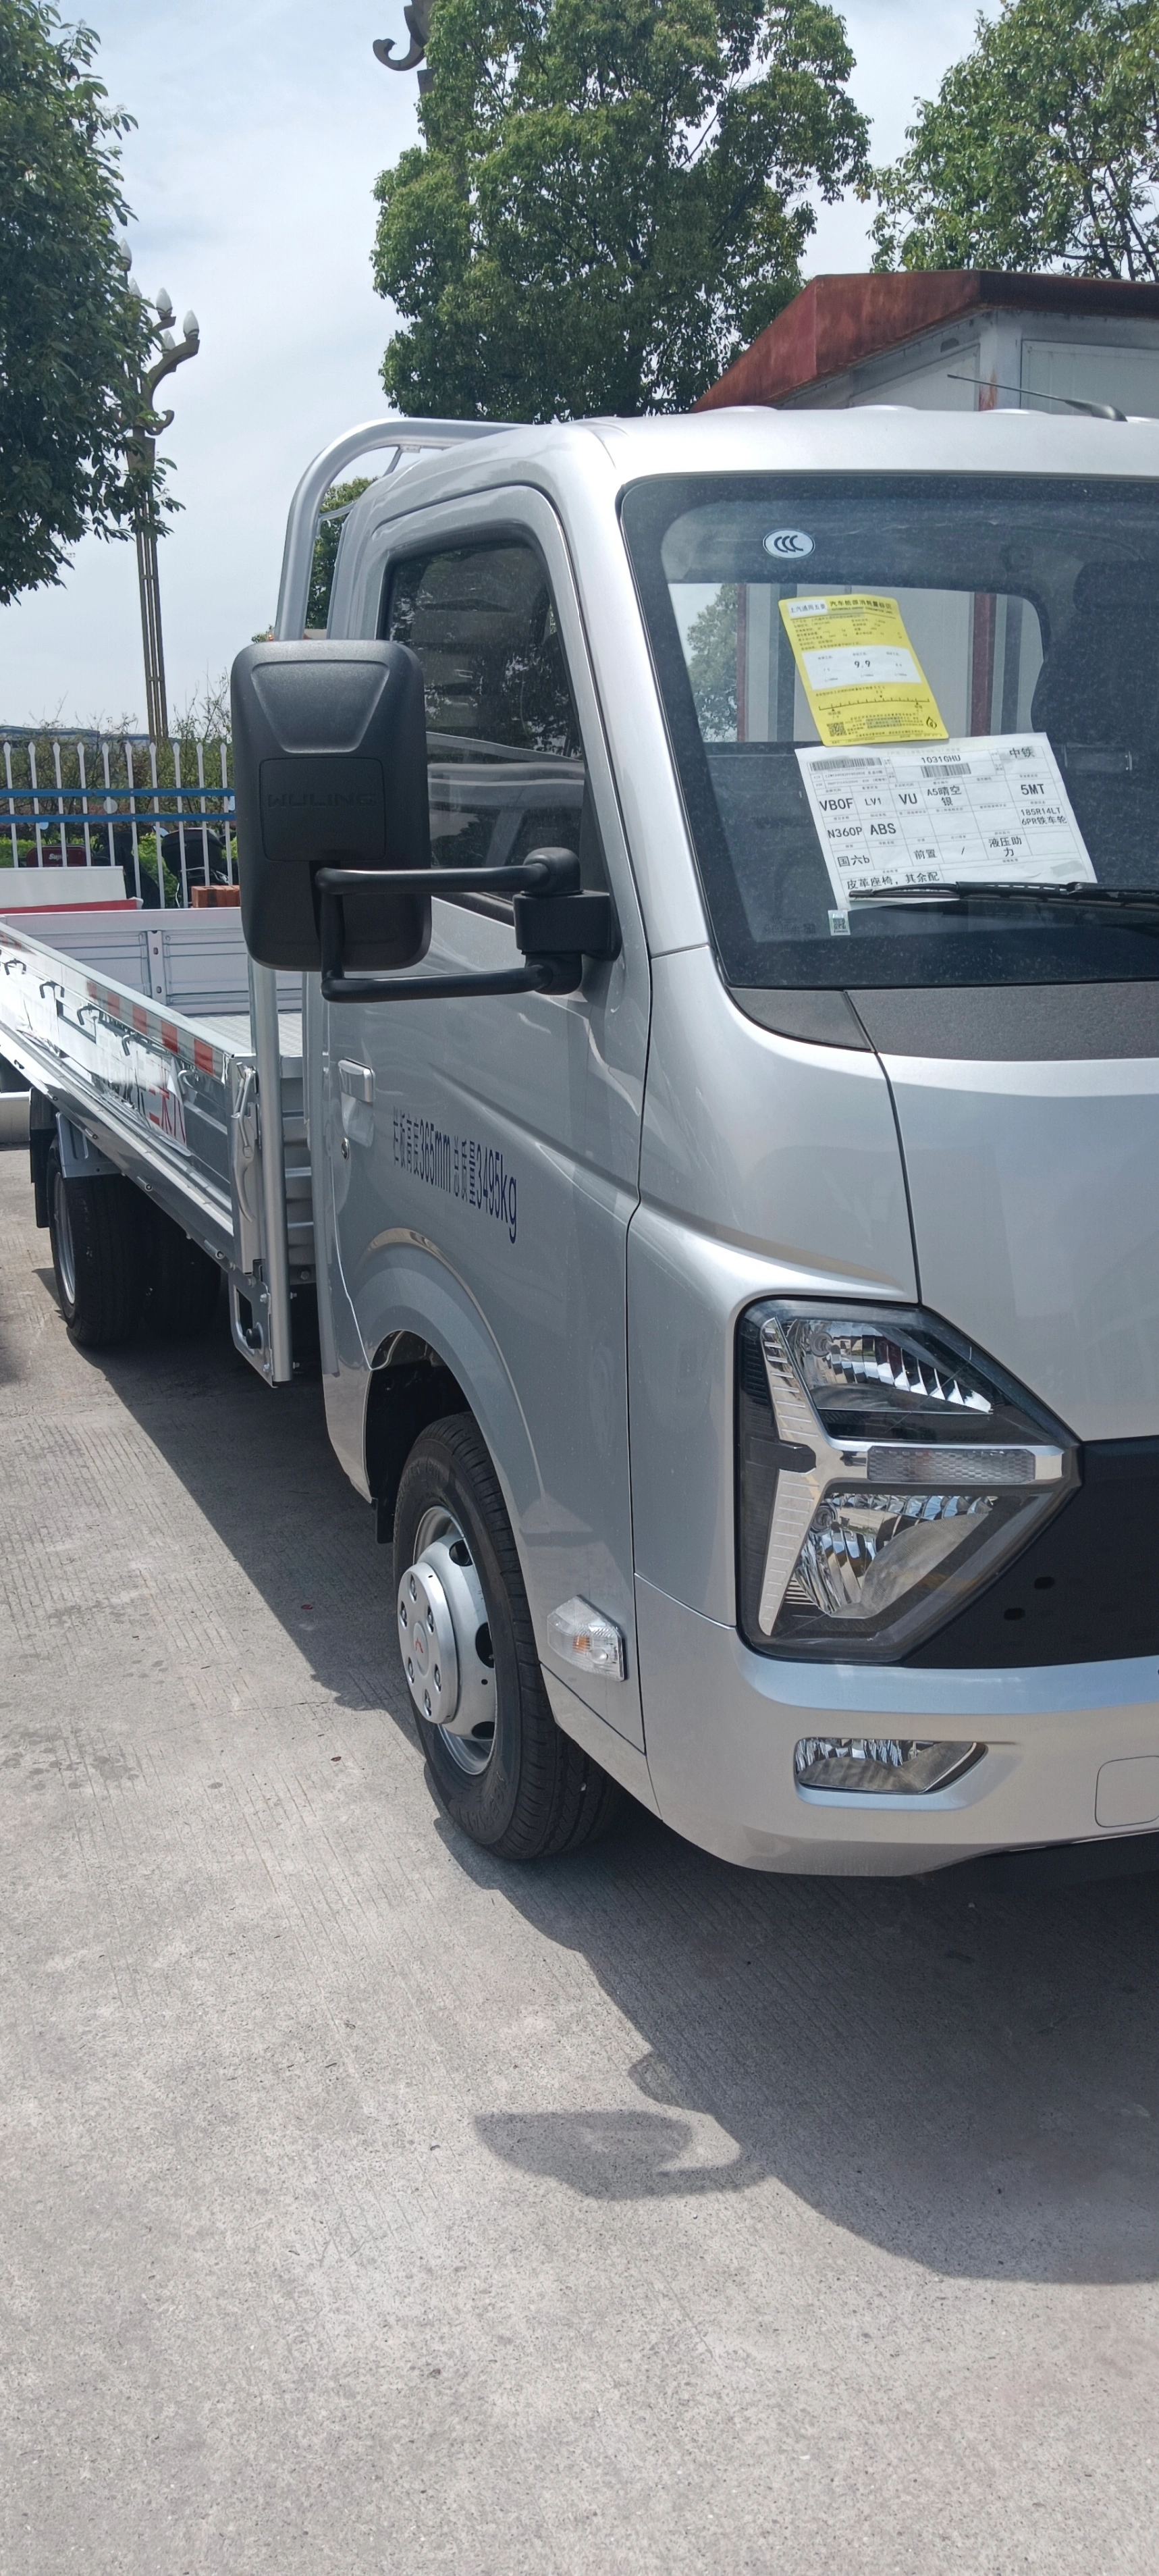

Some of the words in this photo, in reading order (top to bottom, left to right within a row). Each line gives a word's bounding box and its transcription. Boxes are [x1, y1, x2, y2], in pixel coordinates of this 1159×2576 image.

[854, 660, 871, 668] 9.9
[1009, 747, 1035, 758] 中铁
[921, 754, 962, 764] 1031GHU
[927, 785, 963, 797] A5晴空
[1021, 783, 1045, 795] 5MT
[268, 793, 377, 808] WULING
[865, 797, 882, 806] LV1
[898, 793, 918, 805] VU
[941, 797, 953, 806] 银
[1021, 807, 1060, 816] 185R14LT
[827, 826, 863, 839] N360P
[870, 822, 896, 835] ABS
[988, 836, 1022, 848] 液压助
[913, 849, 938, 860] 前置
[1004, 847, 1014, 857] 力
[837, 854, 870, 868] 国六b
